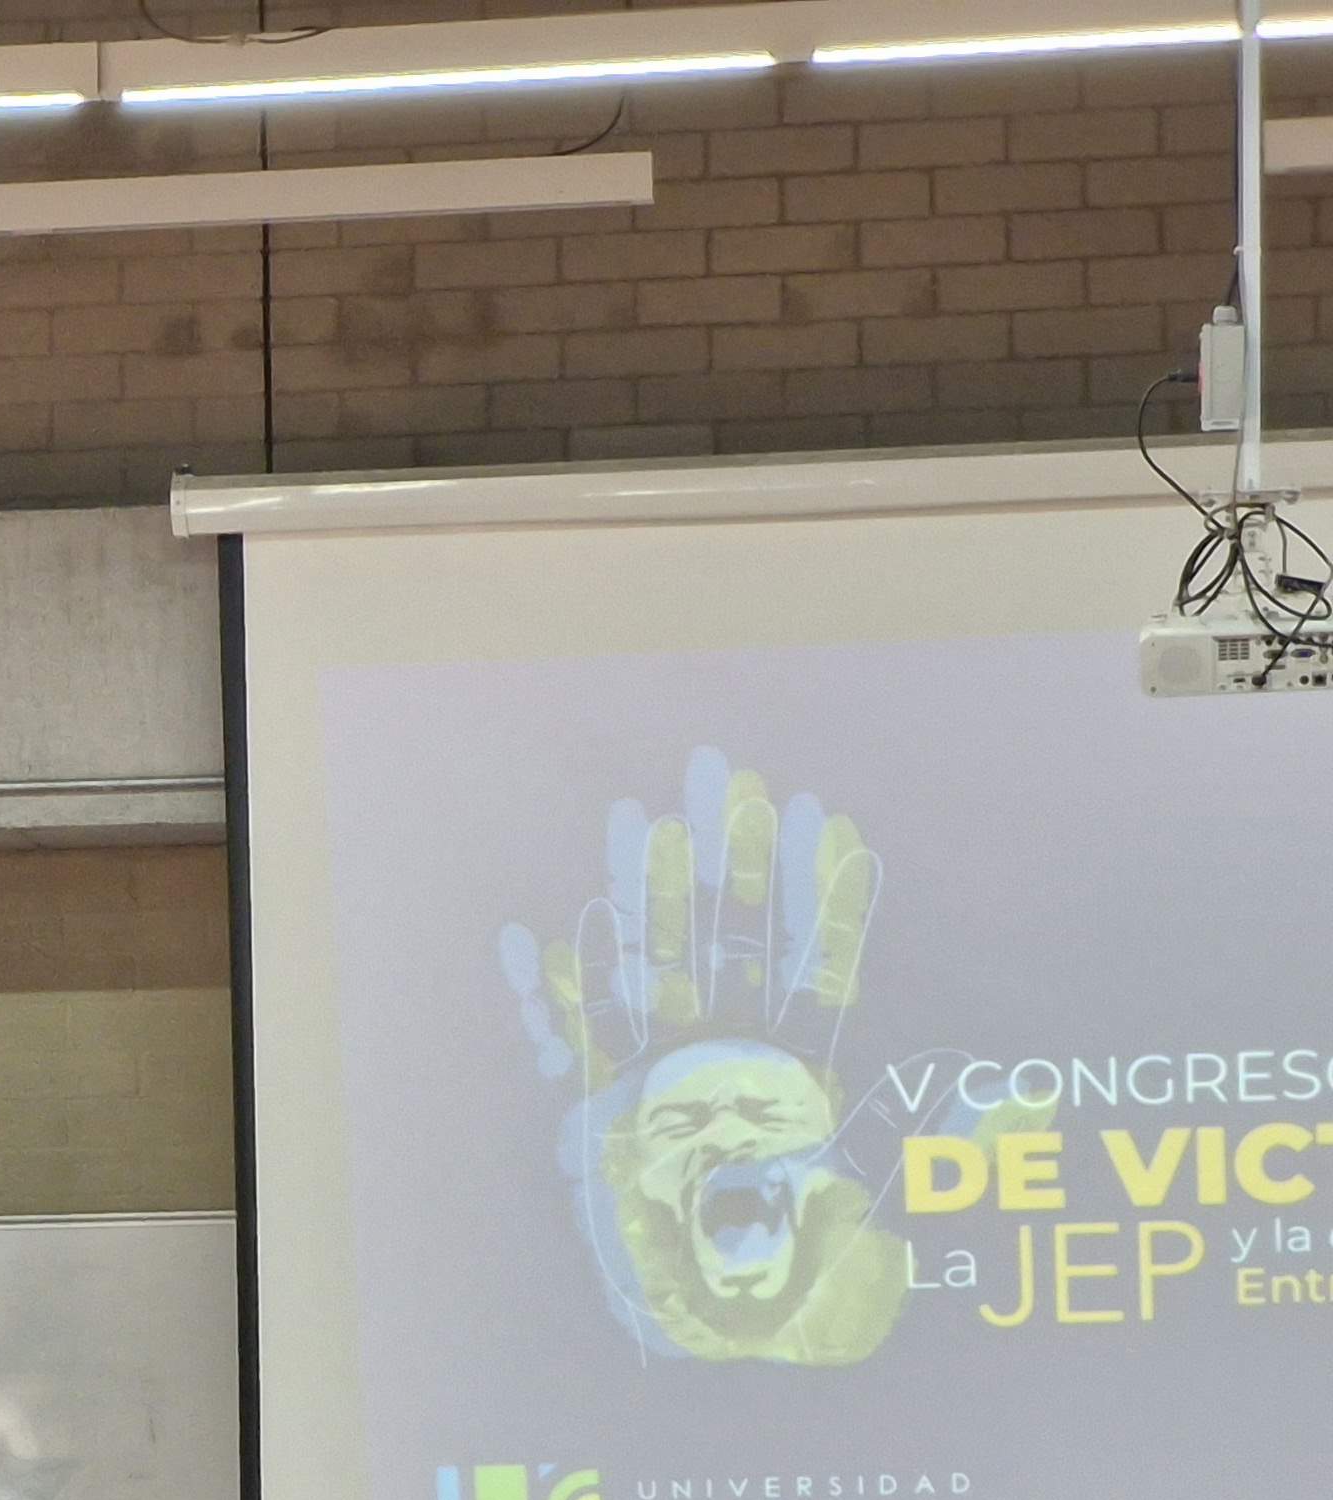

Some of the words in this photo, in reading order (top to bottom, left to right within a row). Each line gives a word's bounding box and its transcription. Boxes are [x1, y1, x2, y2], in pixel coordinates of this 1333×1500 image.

[886, 1062, 935, 1112] V
[957, 1048, 1333, 1111] CONGRES
[902, 1130, 1066, 1214] DE
[1099, 1121, 1333, 1207] VIC
[1230, 1227, 1258, 1263] y
[1275, 1217, 1312, 1252] la
[906, 1240, 977, 1289] La
[978, 1220, 1205, 1328] JEP
[1236, 1267, 1333, 1305] Ent
[636, 1472, 971, 1500] UNIVERSIDAD
